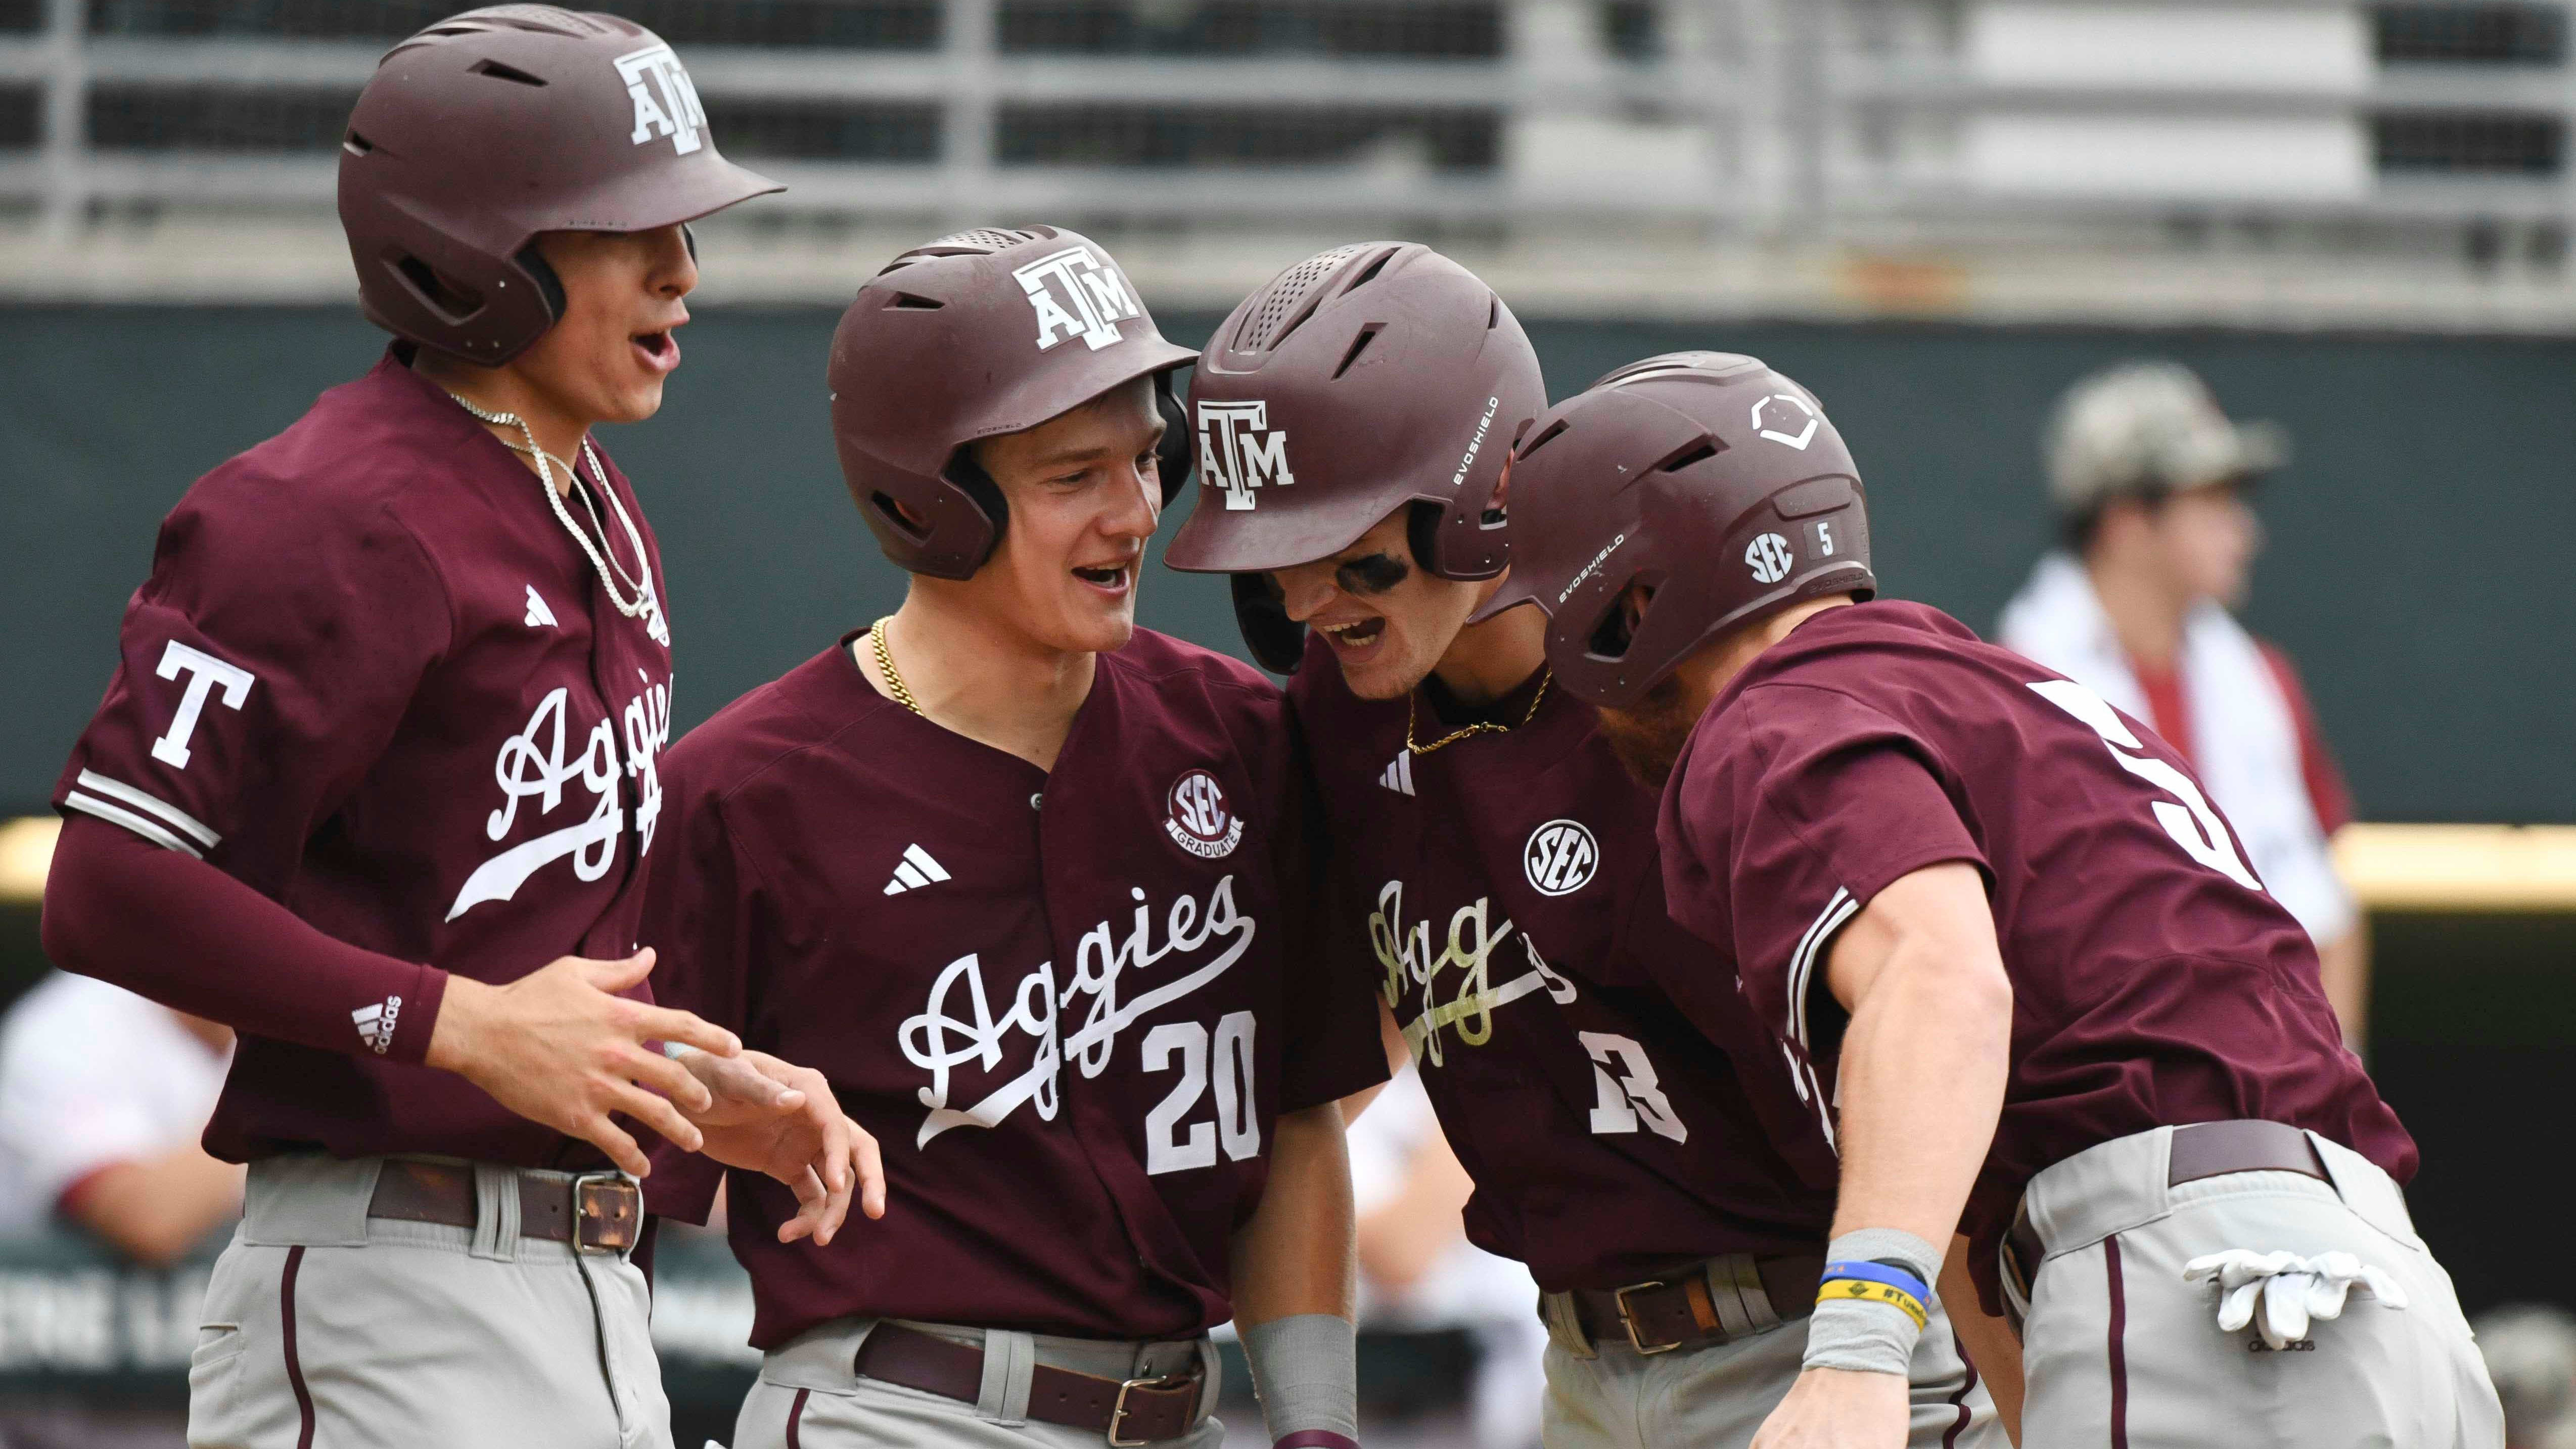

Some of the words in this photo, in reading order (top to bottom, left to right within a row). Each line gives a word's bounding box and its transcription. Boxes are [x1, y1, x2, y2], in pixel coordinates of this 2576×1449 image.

[1453, 397, 1498, 485] EVOSHIELD
[1559, 534, 1624, 603] EVOSHIELD
[1745, 532, 1793, 583] SEC
[1818, 522, 1833, 556] 5
[152, 639, 255, 770] T
[1176, 775, 1225, 836] SEC
[1177, 832, 1237, 856] GRADUATE
[1532, 827, 1591, 890] SEC
[898, 875, 1256, 1121] Aggies
[1141, 1010, 1261, 1175] 20
